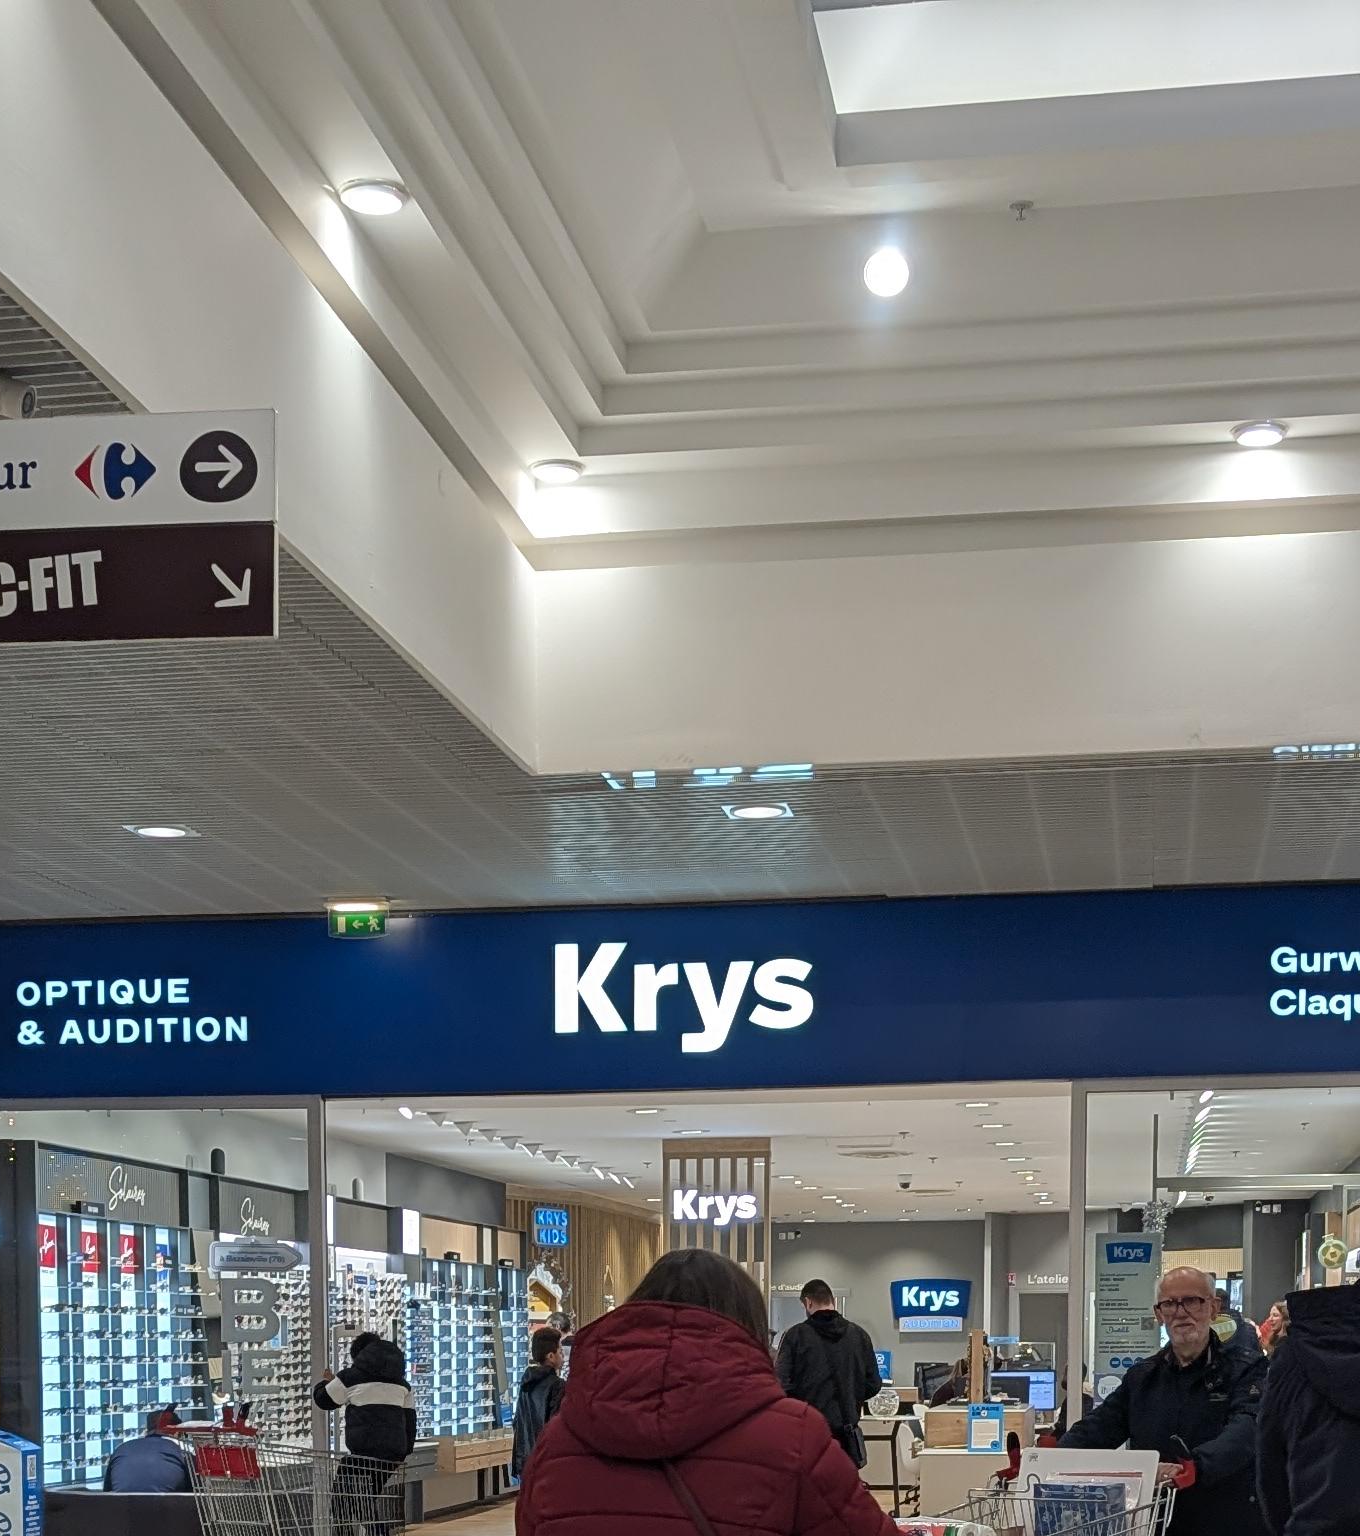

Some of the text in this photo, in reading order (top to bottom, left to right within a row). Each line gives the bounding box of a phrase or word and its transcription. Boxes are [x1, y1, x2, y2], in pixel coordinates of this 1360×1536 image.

[16, 978, 190, 1007] OPTIQUE
[554, 942, 814, 1053] Krys
[16, 1016, 248, 1045] & AUDITION
[538, 1210, 568, 1226] KRYS
[671, 1189, 757, 1227] Krys
[540, 1228, 567, 1244] KIDS
[1114, 1246, 1145, 1260] Krys
[1027, 1274, 1069, 1285] L'atelie
[902, 1286, 960, 1312] Krys
[902, 1319, 961, 1329] AUDITION
